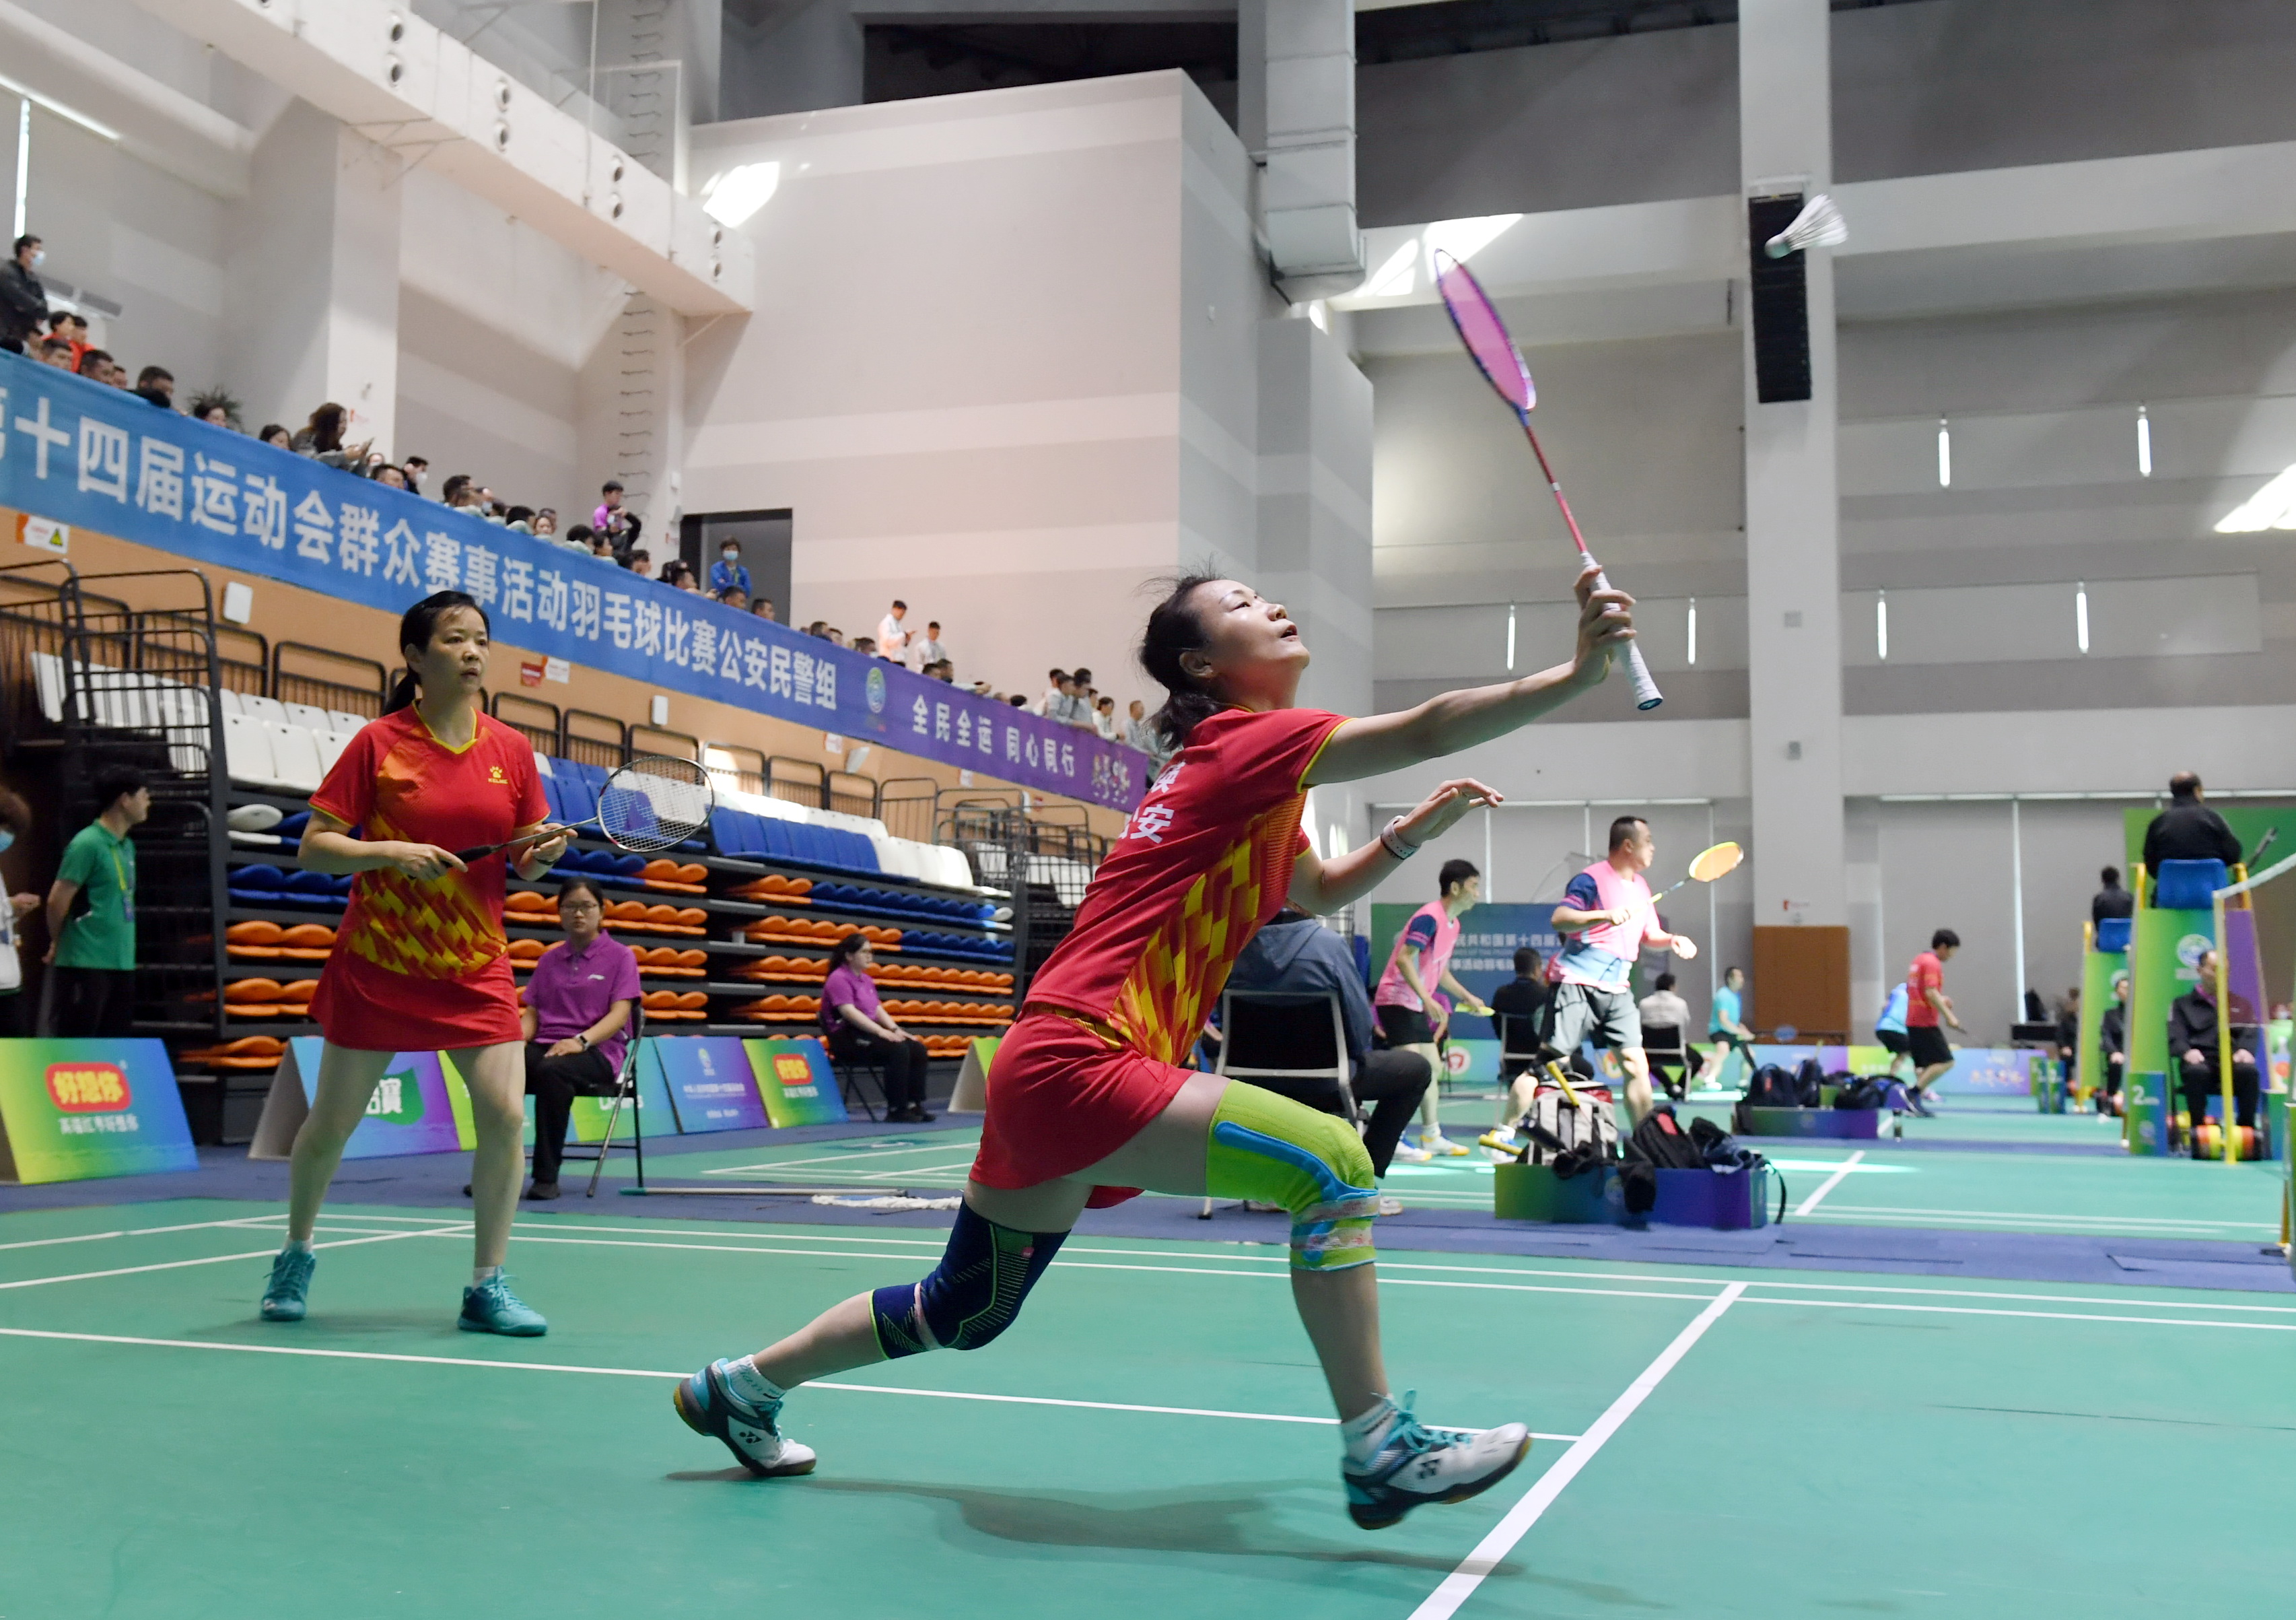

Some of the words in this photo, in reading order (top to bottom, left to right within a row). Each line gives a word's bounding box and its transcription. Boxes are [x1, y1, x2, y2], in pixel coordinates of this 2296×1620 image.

[913, 694, 992, 755] 全民全运
[53, 1070, 125, 1104] 好想你
